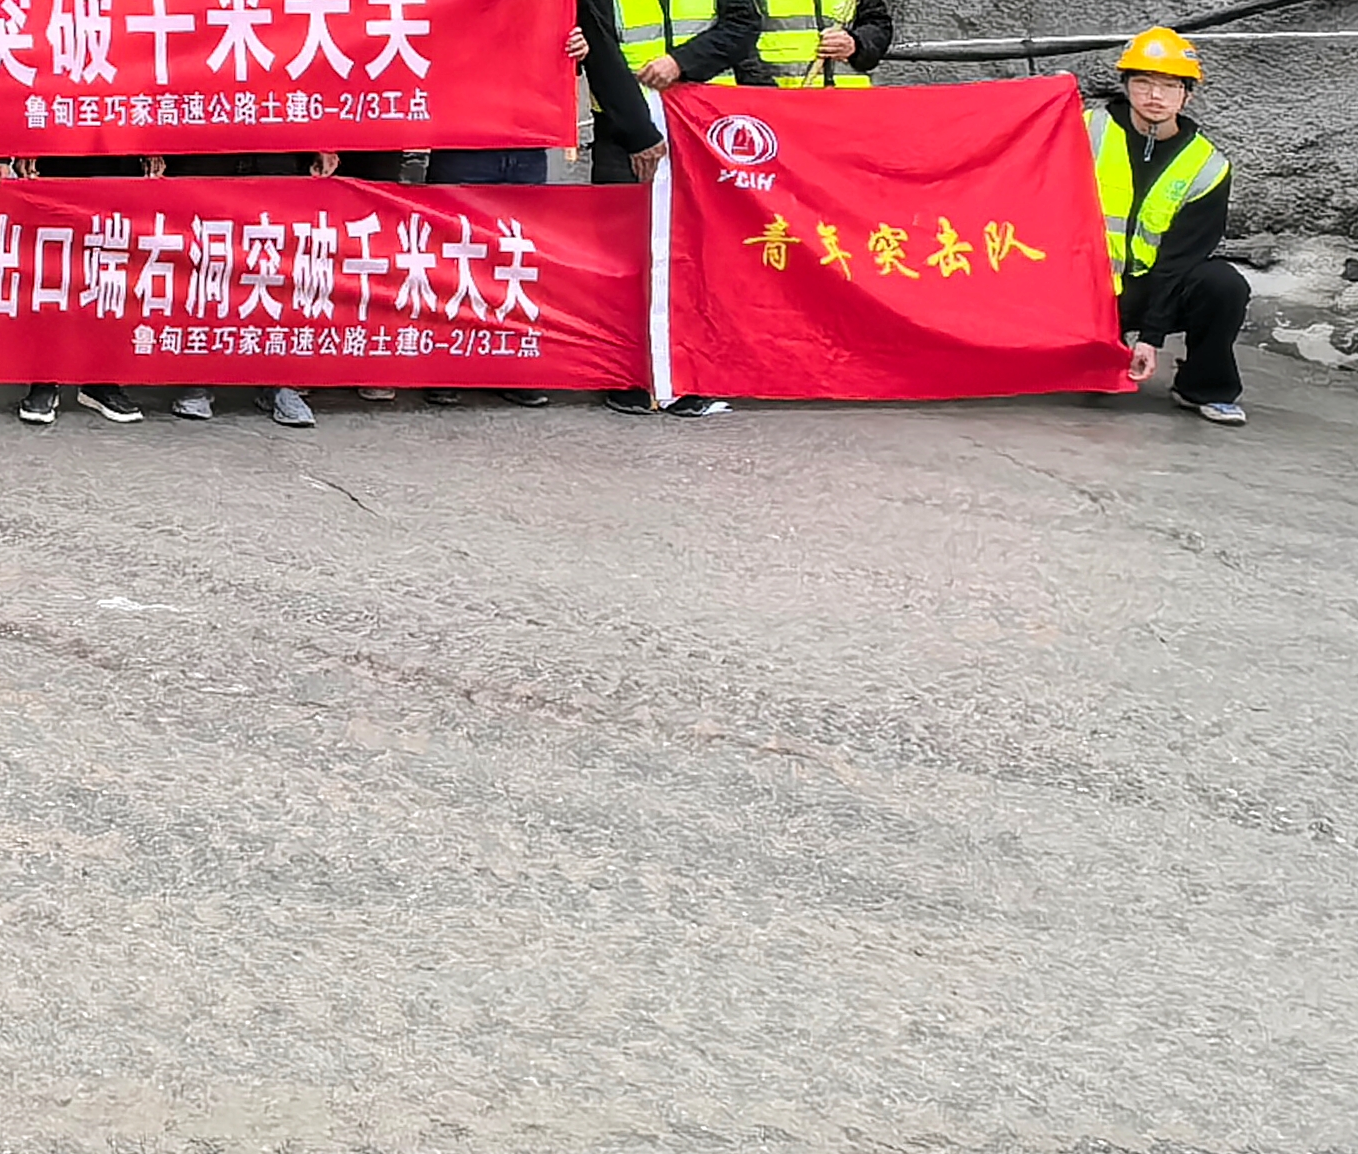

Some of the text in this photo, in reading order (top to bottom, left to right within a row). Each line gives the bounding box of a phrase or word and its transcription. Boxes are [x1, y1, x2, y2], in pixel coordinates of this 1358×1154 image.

[24, 88, 431, 129] 鲁甸至巧家高速公路土建6-2/3工点
[743, 213, 1047, 280] 青年突击队
[131, 324, 542, 359] 鲁甸至巧家高速公路土建6-2/3工点
